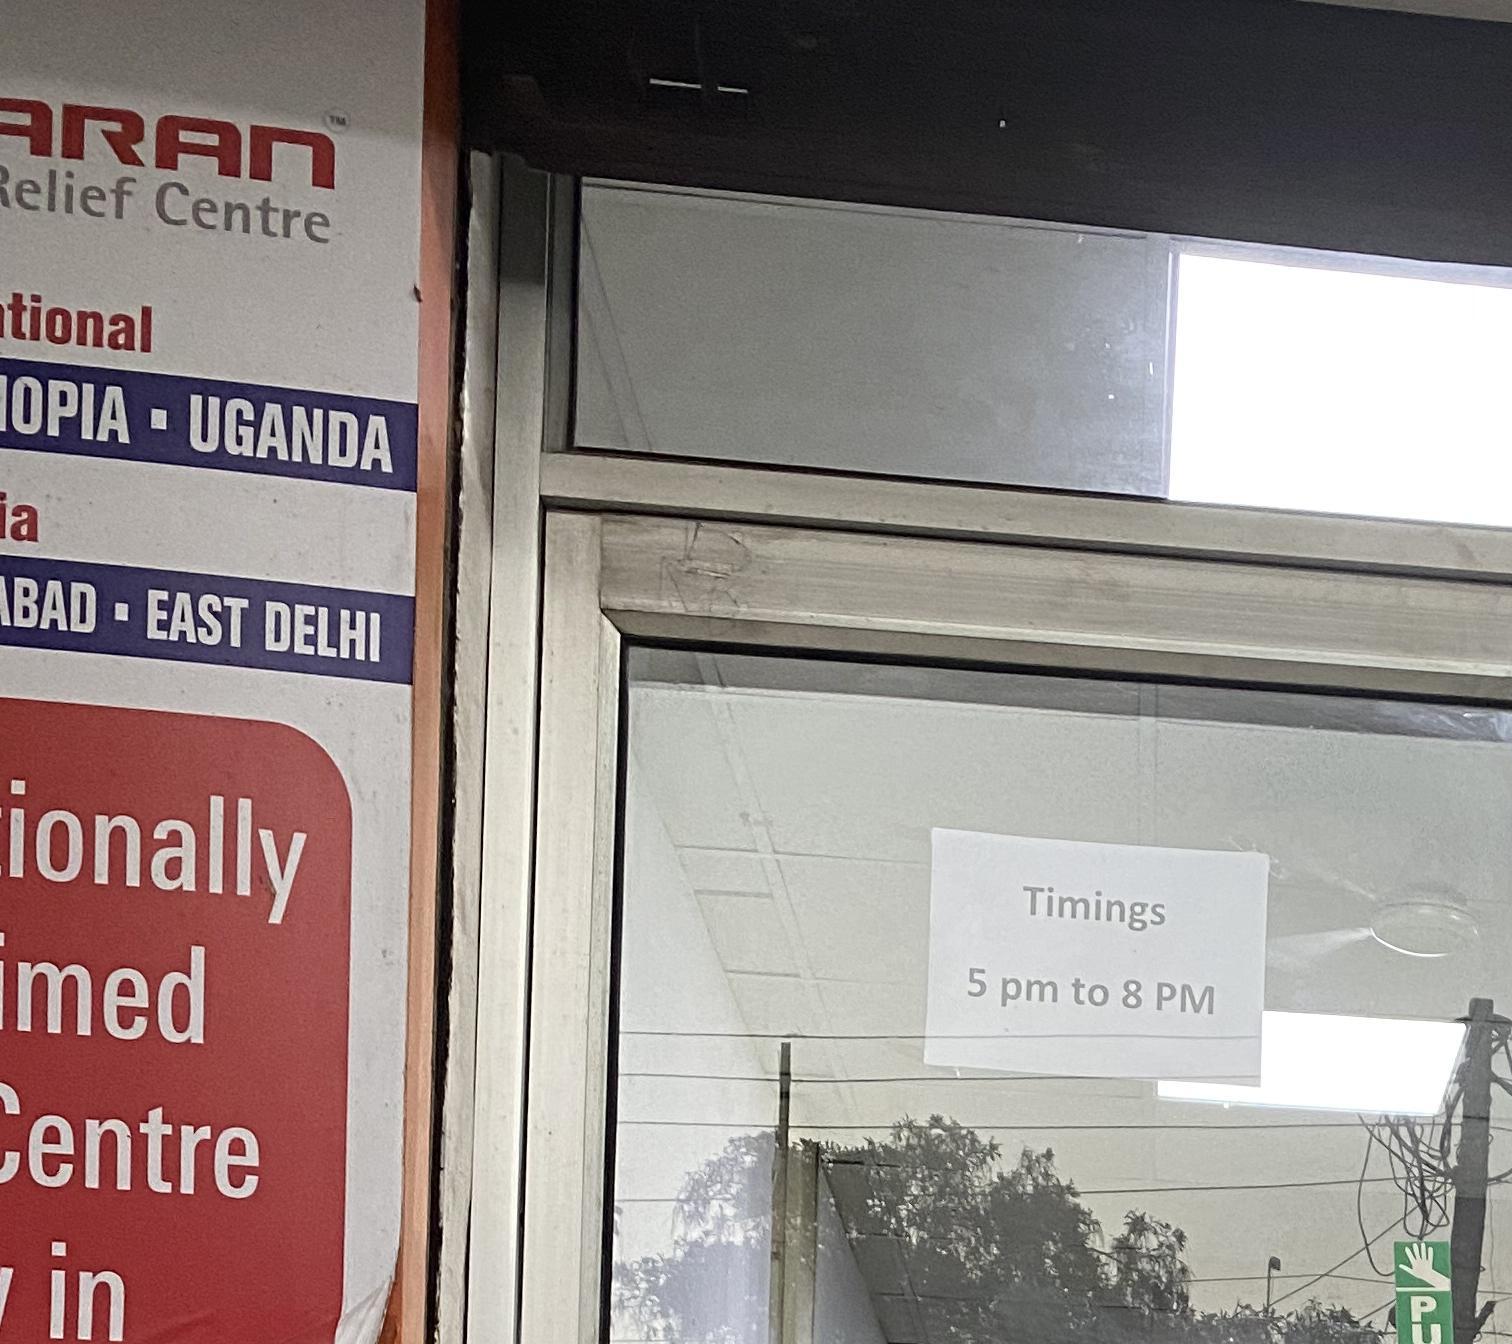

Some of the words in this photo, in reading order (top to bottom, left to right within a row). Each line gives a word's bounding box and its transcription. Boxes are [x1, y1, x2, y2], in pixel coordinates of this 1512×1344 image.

[155, 181, 331, 243] Centre
[0, 292, 152, 353] tional
[189, 394, 393, 473] UGANDA
[147, 589, 249, 647] EAST
[264, 603, 380, 662] DELHI
[1023, 885, 1166, 931] Timings
[967, 967, 987, 998] 5
[1001, 976, 1058, 1007] pm
[1072, 977, 1109, 1007] to
[1122, 980, 1143, 1009] 8
[1156, 982, 1215, 1015] PM
[49, 1241, 126, 1342] in
